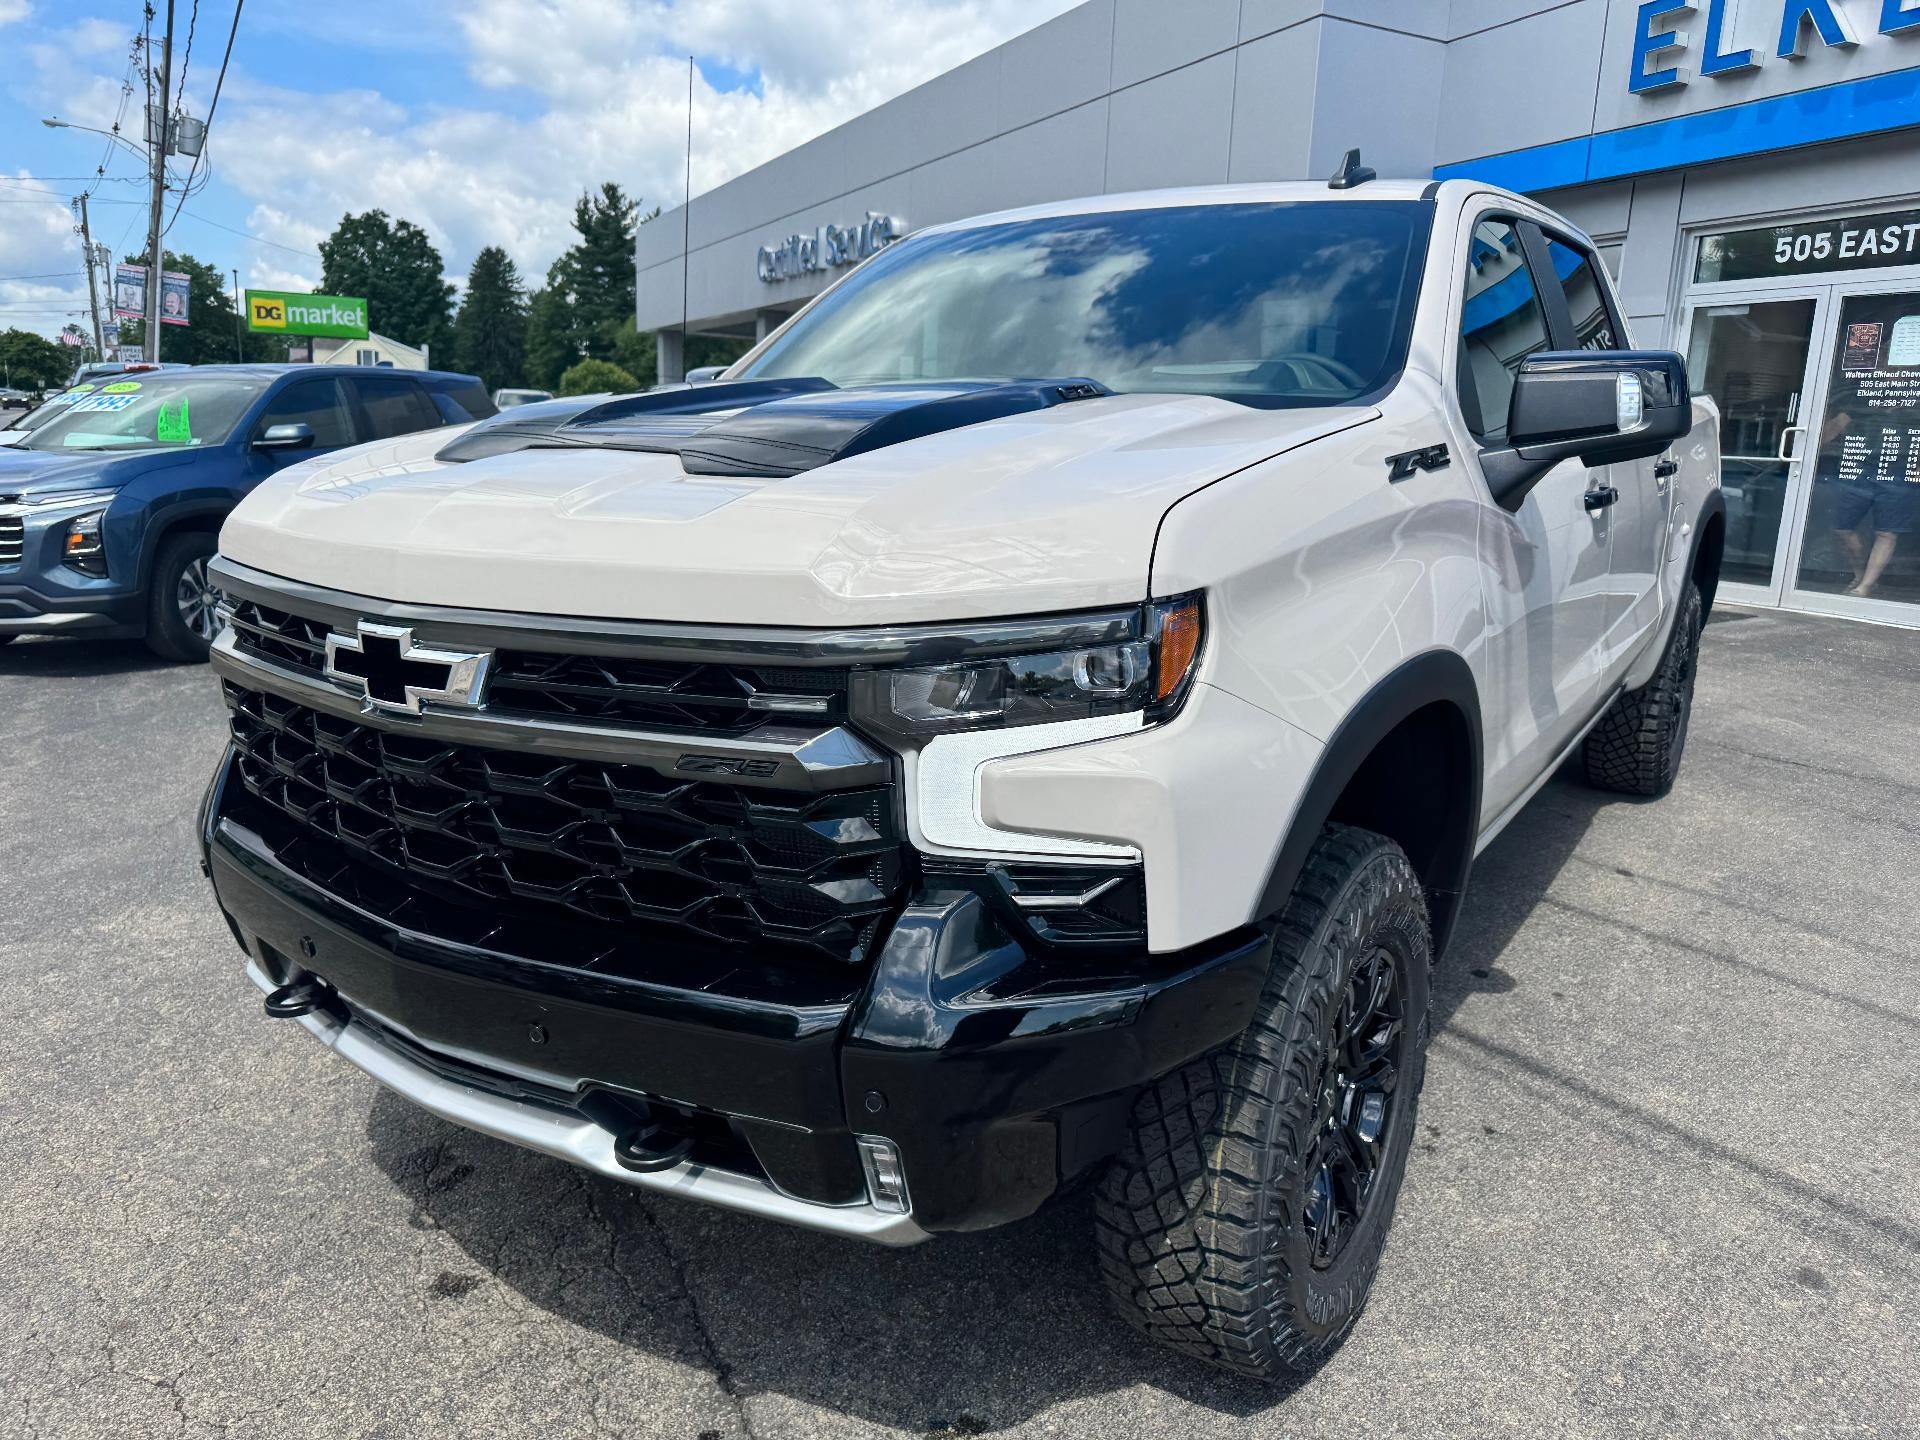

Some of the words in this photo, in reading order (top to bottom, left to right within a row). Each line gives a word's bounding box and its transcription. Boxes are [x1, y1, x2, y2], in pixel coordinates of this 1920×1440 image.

[758, 226, 818, 282] Certified
[825, 210, 894, 267] Service
[1774, 231, 1832, 264] 505
[1838, 223, 1920, 259] EAST
[254, 304, 282, 321] DG
[287, 303, 364, 327] market
[1845, 371, 1872, 379] Walters
[1873, 370, 1900, 378] Elkland
[1860, 380, 1874, 388] 505
[1874, 380, 1890, 388] East
[1890, 380, 1908, 388] Main
[1857, 389, 1884, 397] Elkland,
